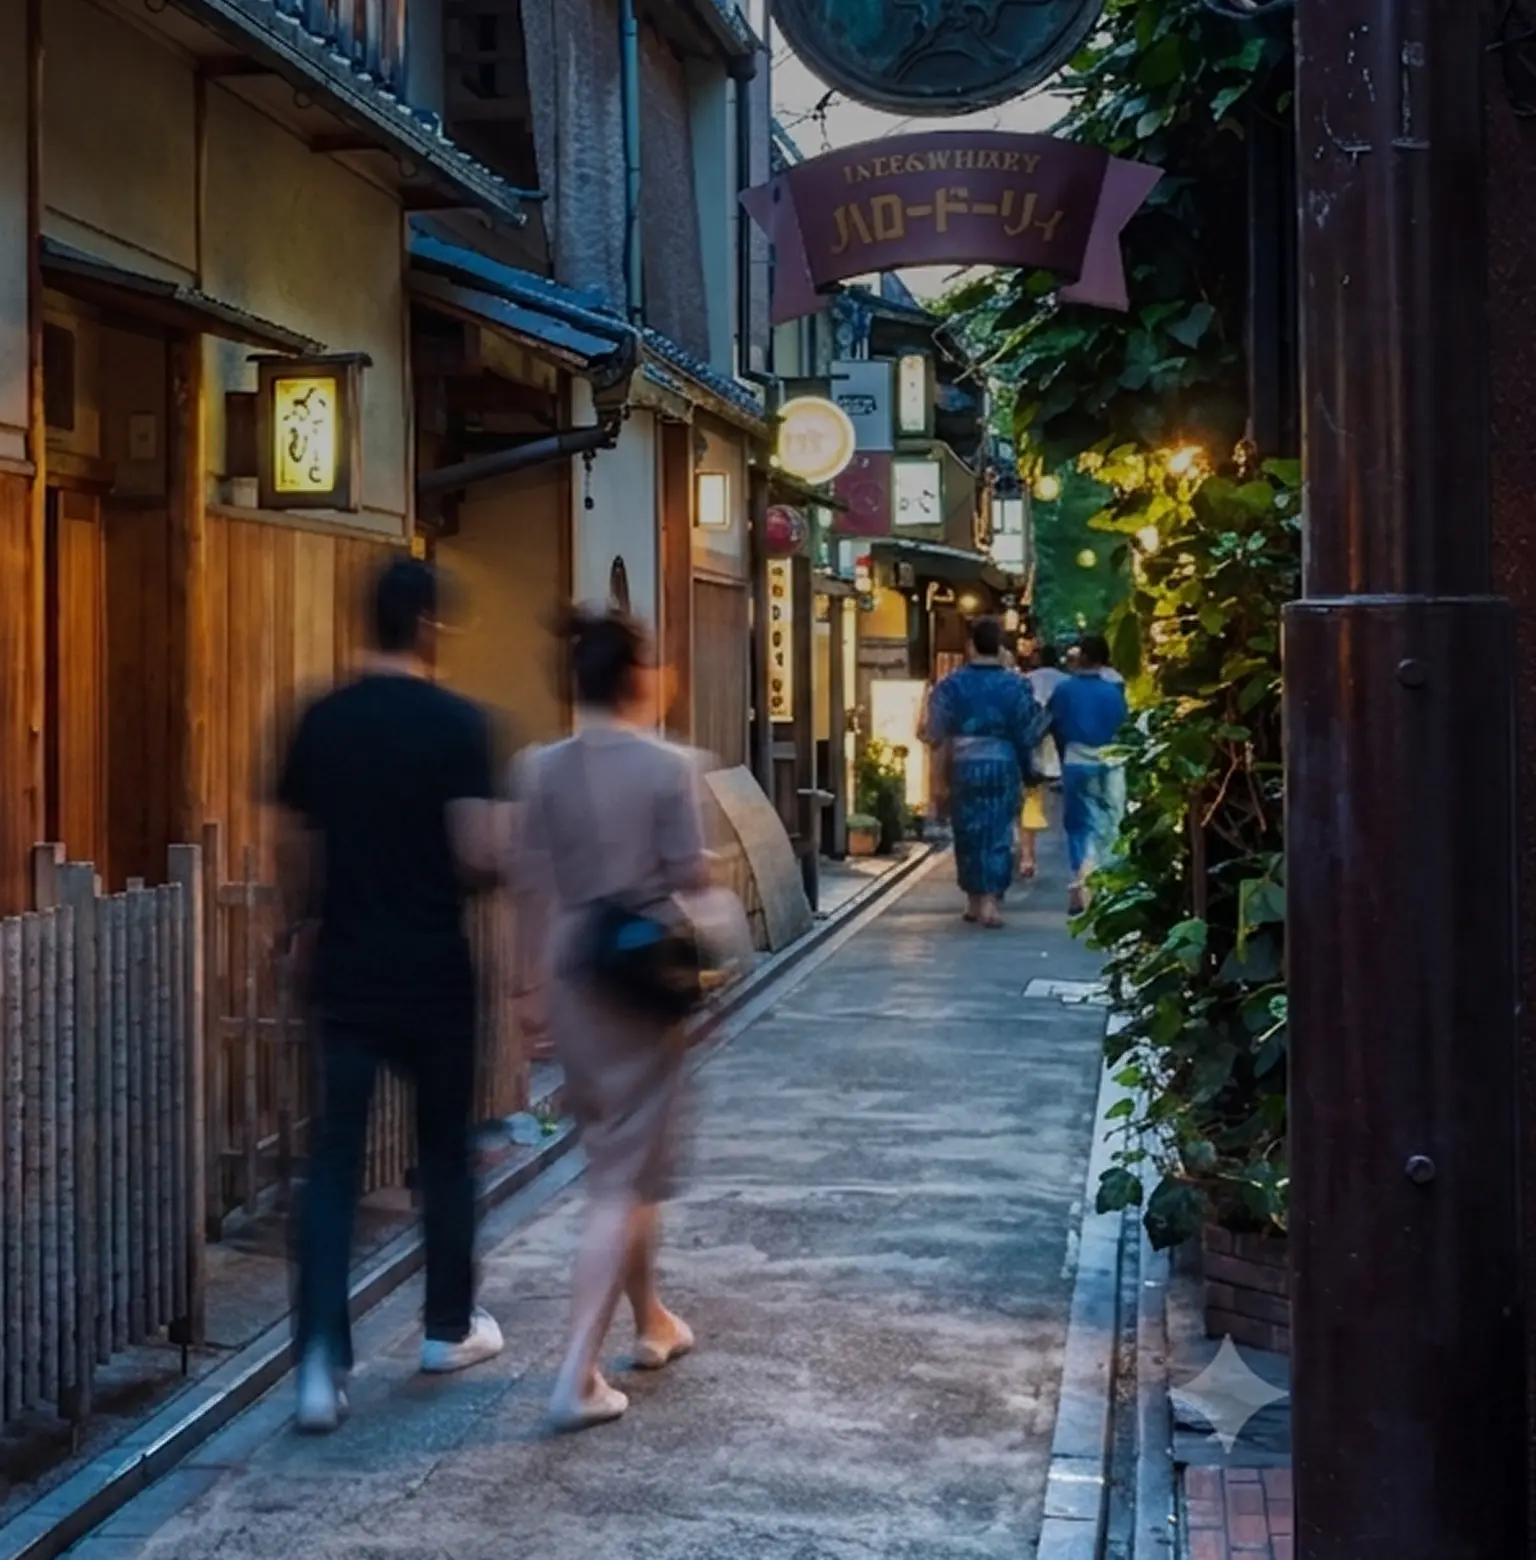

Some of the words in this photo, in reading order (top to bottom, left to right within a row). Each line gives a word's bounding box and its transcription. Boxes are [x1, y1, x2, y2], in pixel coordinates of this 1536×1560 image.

[830, 186, 1065, 255] ハロードーリィ
